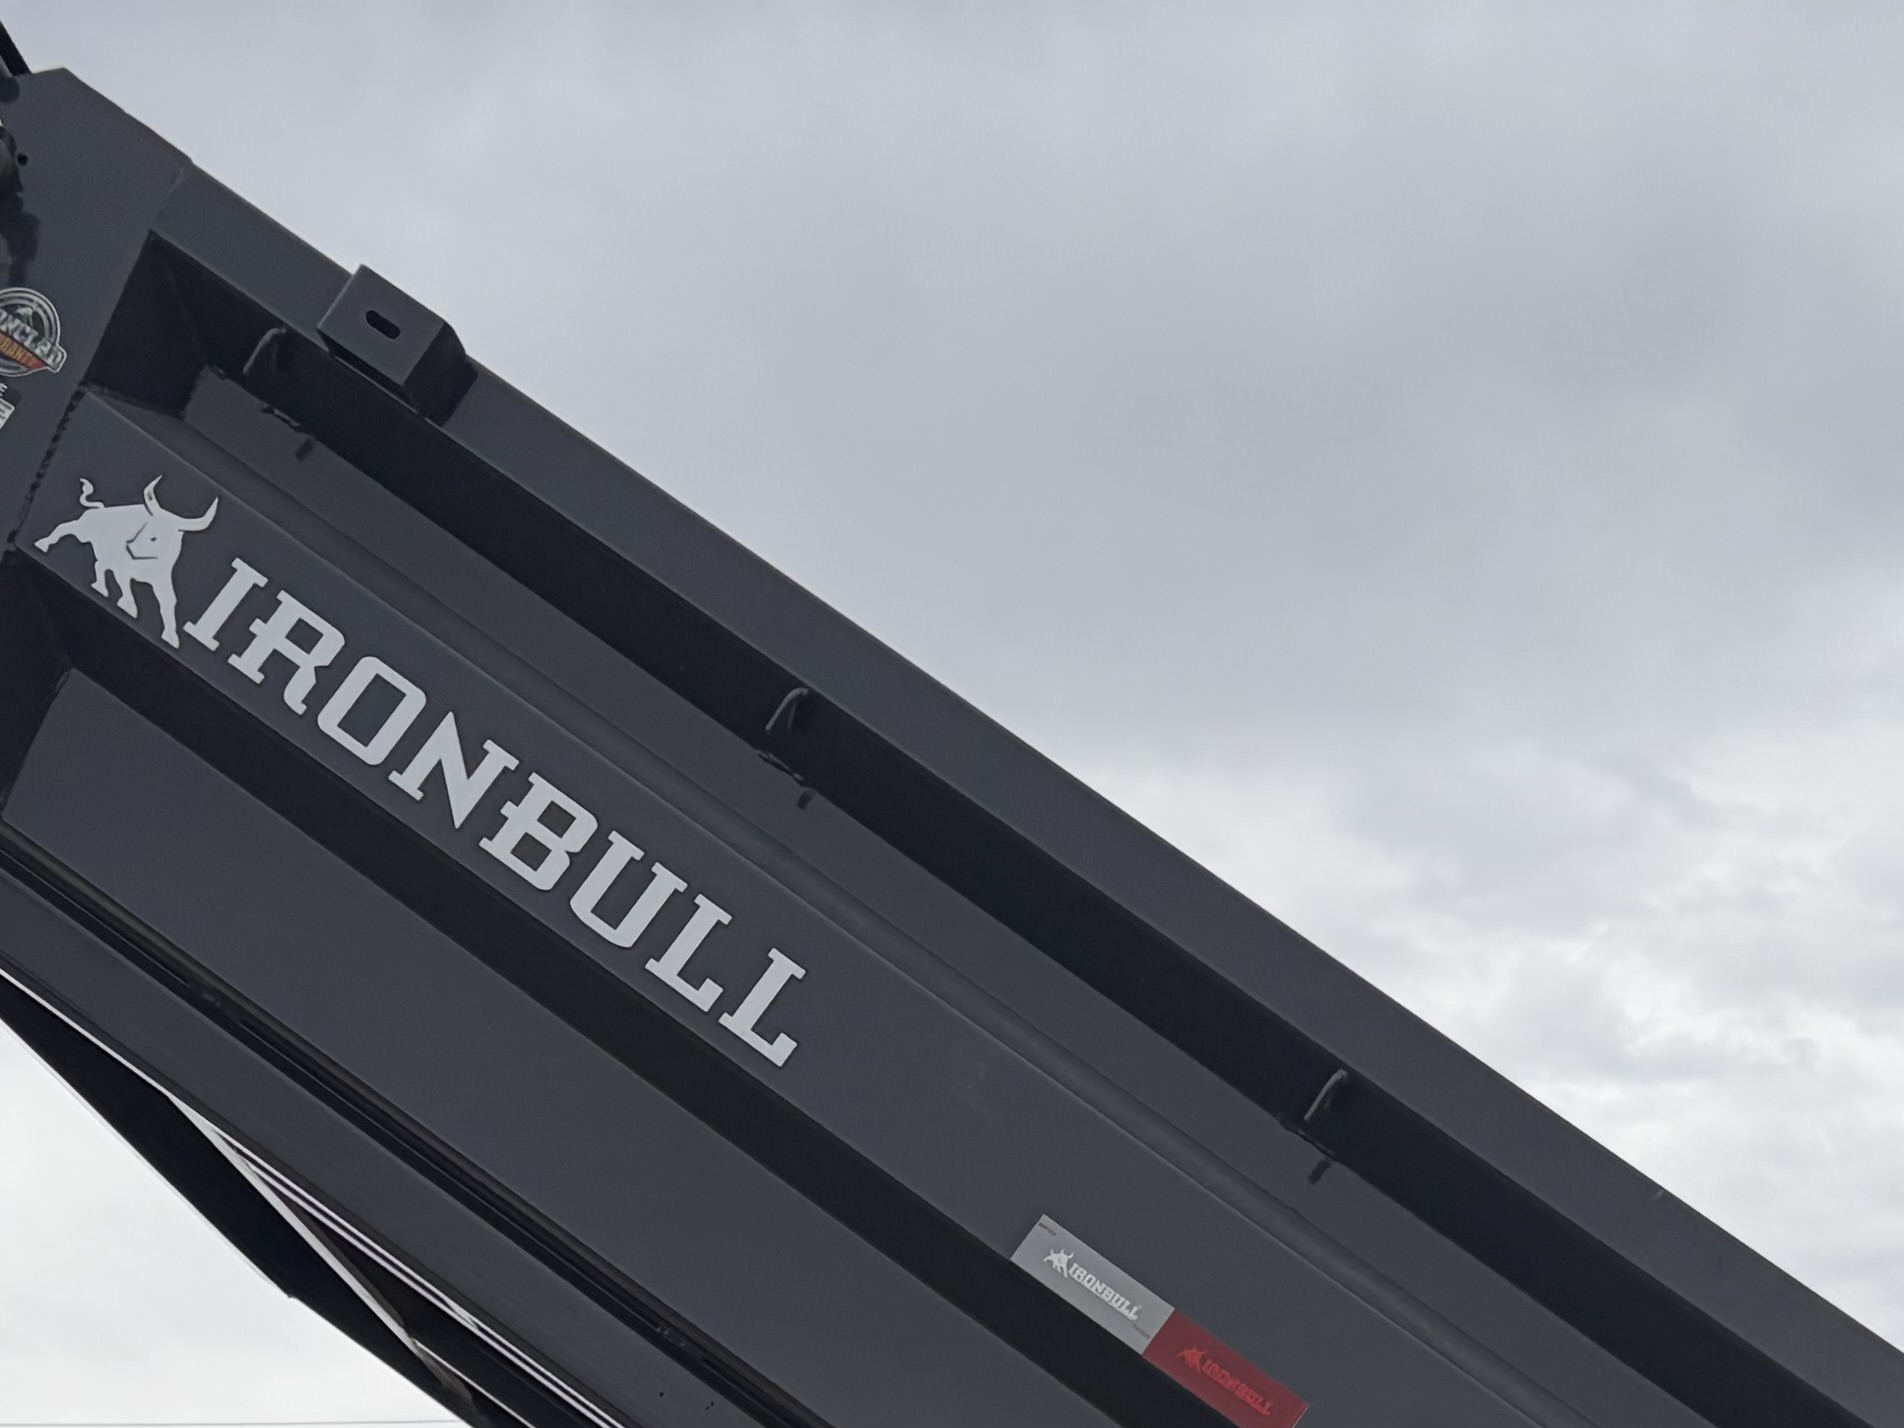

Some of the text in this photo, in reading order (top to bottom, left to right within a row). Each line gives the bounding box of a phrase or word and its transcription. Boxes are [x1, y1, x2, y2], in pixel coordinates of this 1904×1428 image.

[183, 556, 807, 1068] IRONBULL
[1068, 1261, 1141, 1321] IRONBULL
[1201, 1358, 1272, 1416] IRONBULL
